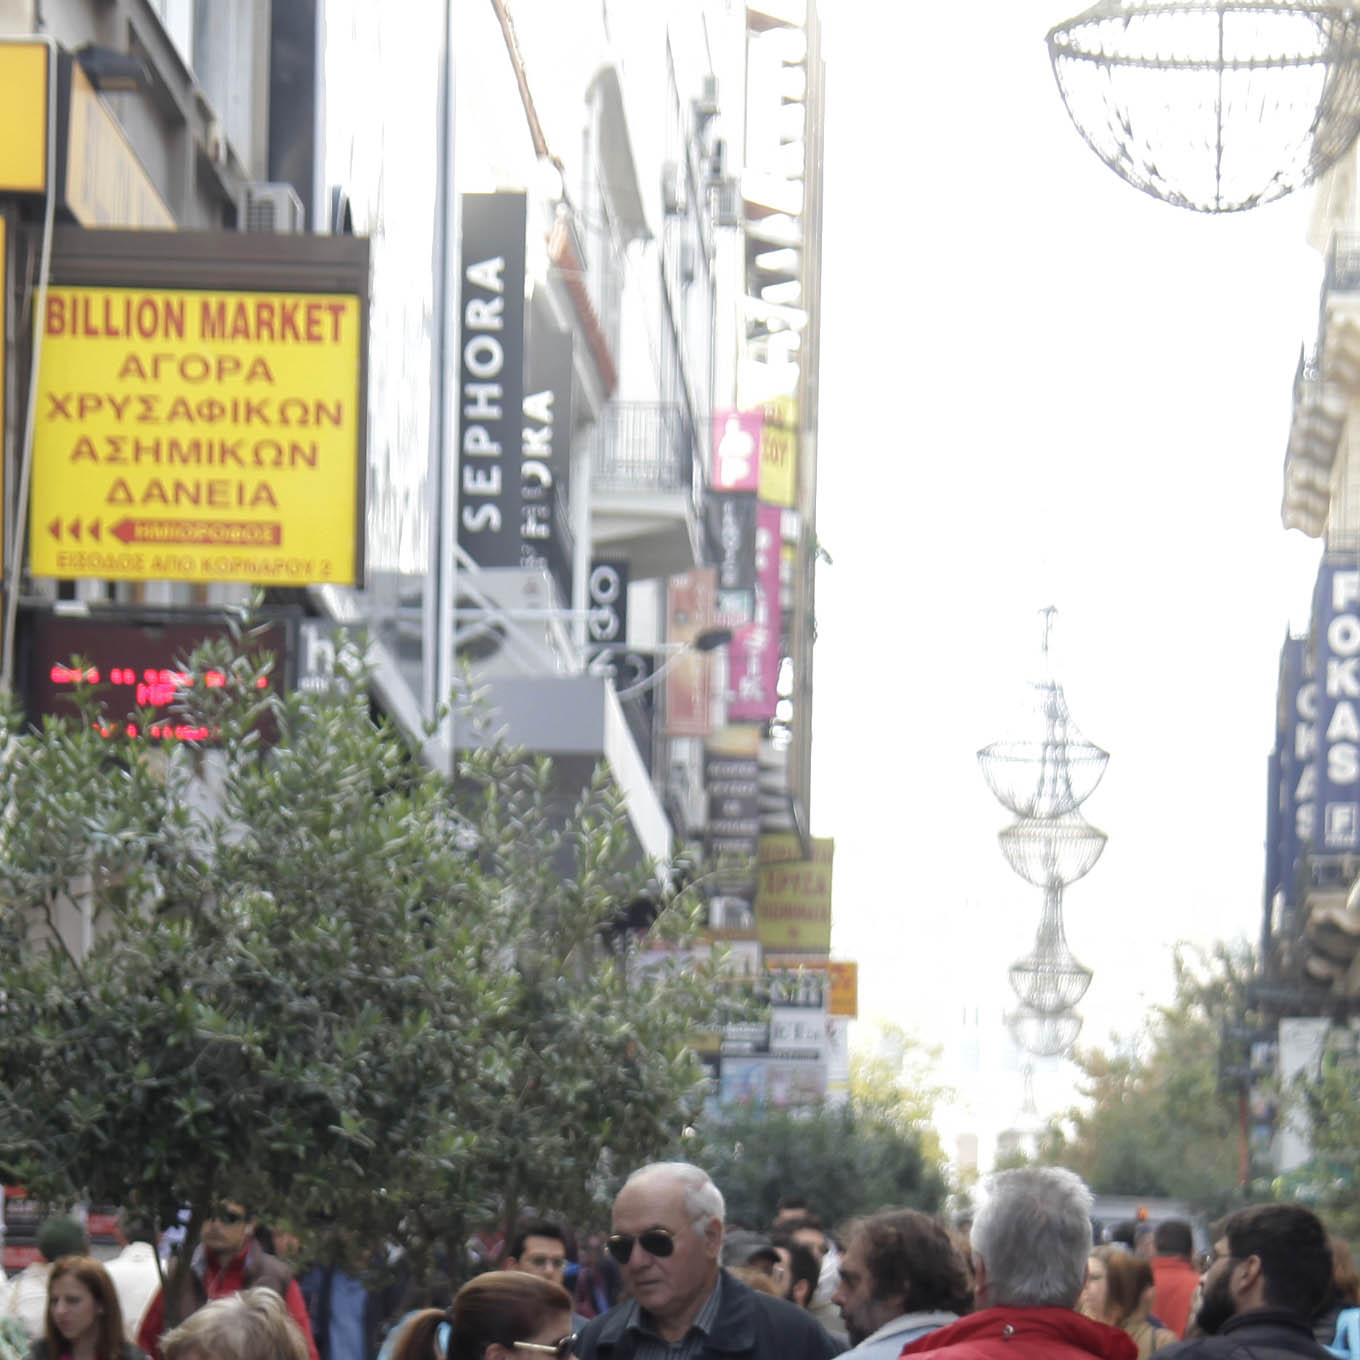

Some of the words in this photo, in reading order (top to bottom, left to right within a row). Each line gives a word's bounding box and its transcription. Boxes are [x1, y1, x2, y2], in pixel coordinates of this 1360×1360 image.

[46, 296, 186, 340] BILLION
[200, 299, 346, 343] MARKET
[117, 352, 275, 385] ΑΓΟΡΑ
[47, 391, 343, 426] ΧΡΥΣΑΦΙΚΩΝ
[461, 255, 507, 534] SEPHORA
[70, 434, 319, 469] ΑΣΗΜΙΚΩΝ
[105, 477, 279, 509] ΔΑΝΕΙΑ
